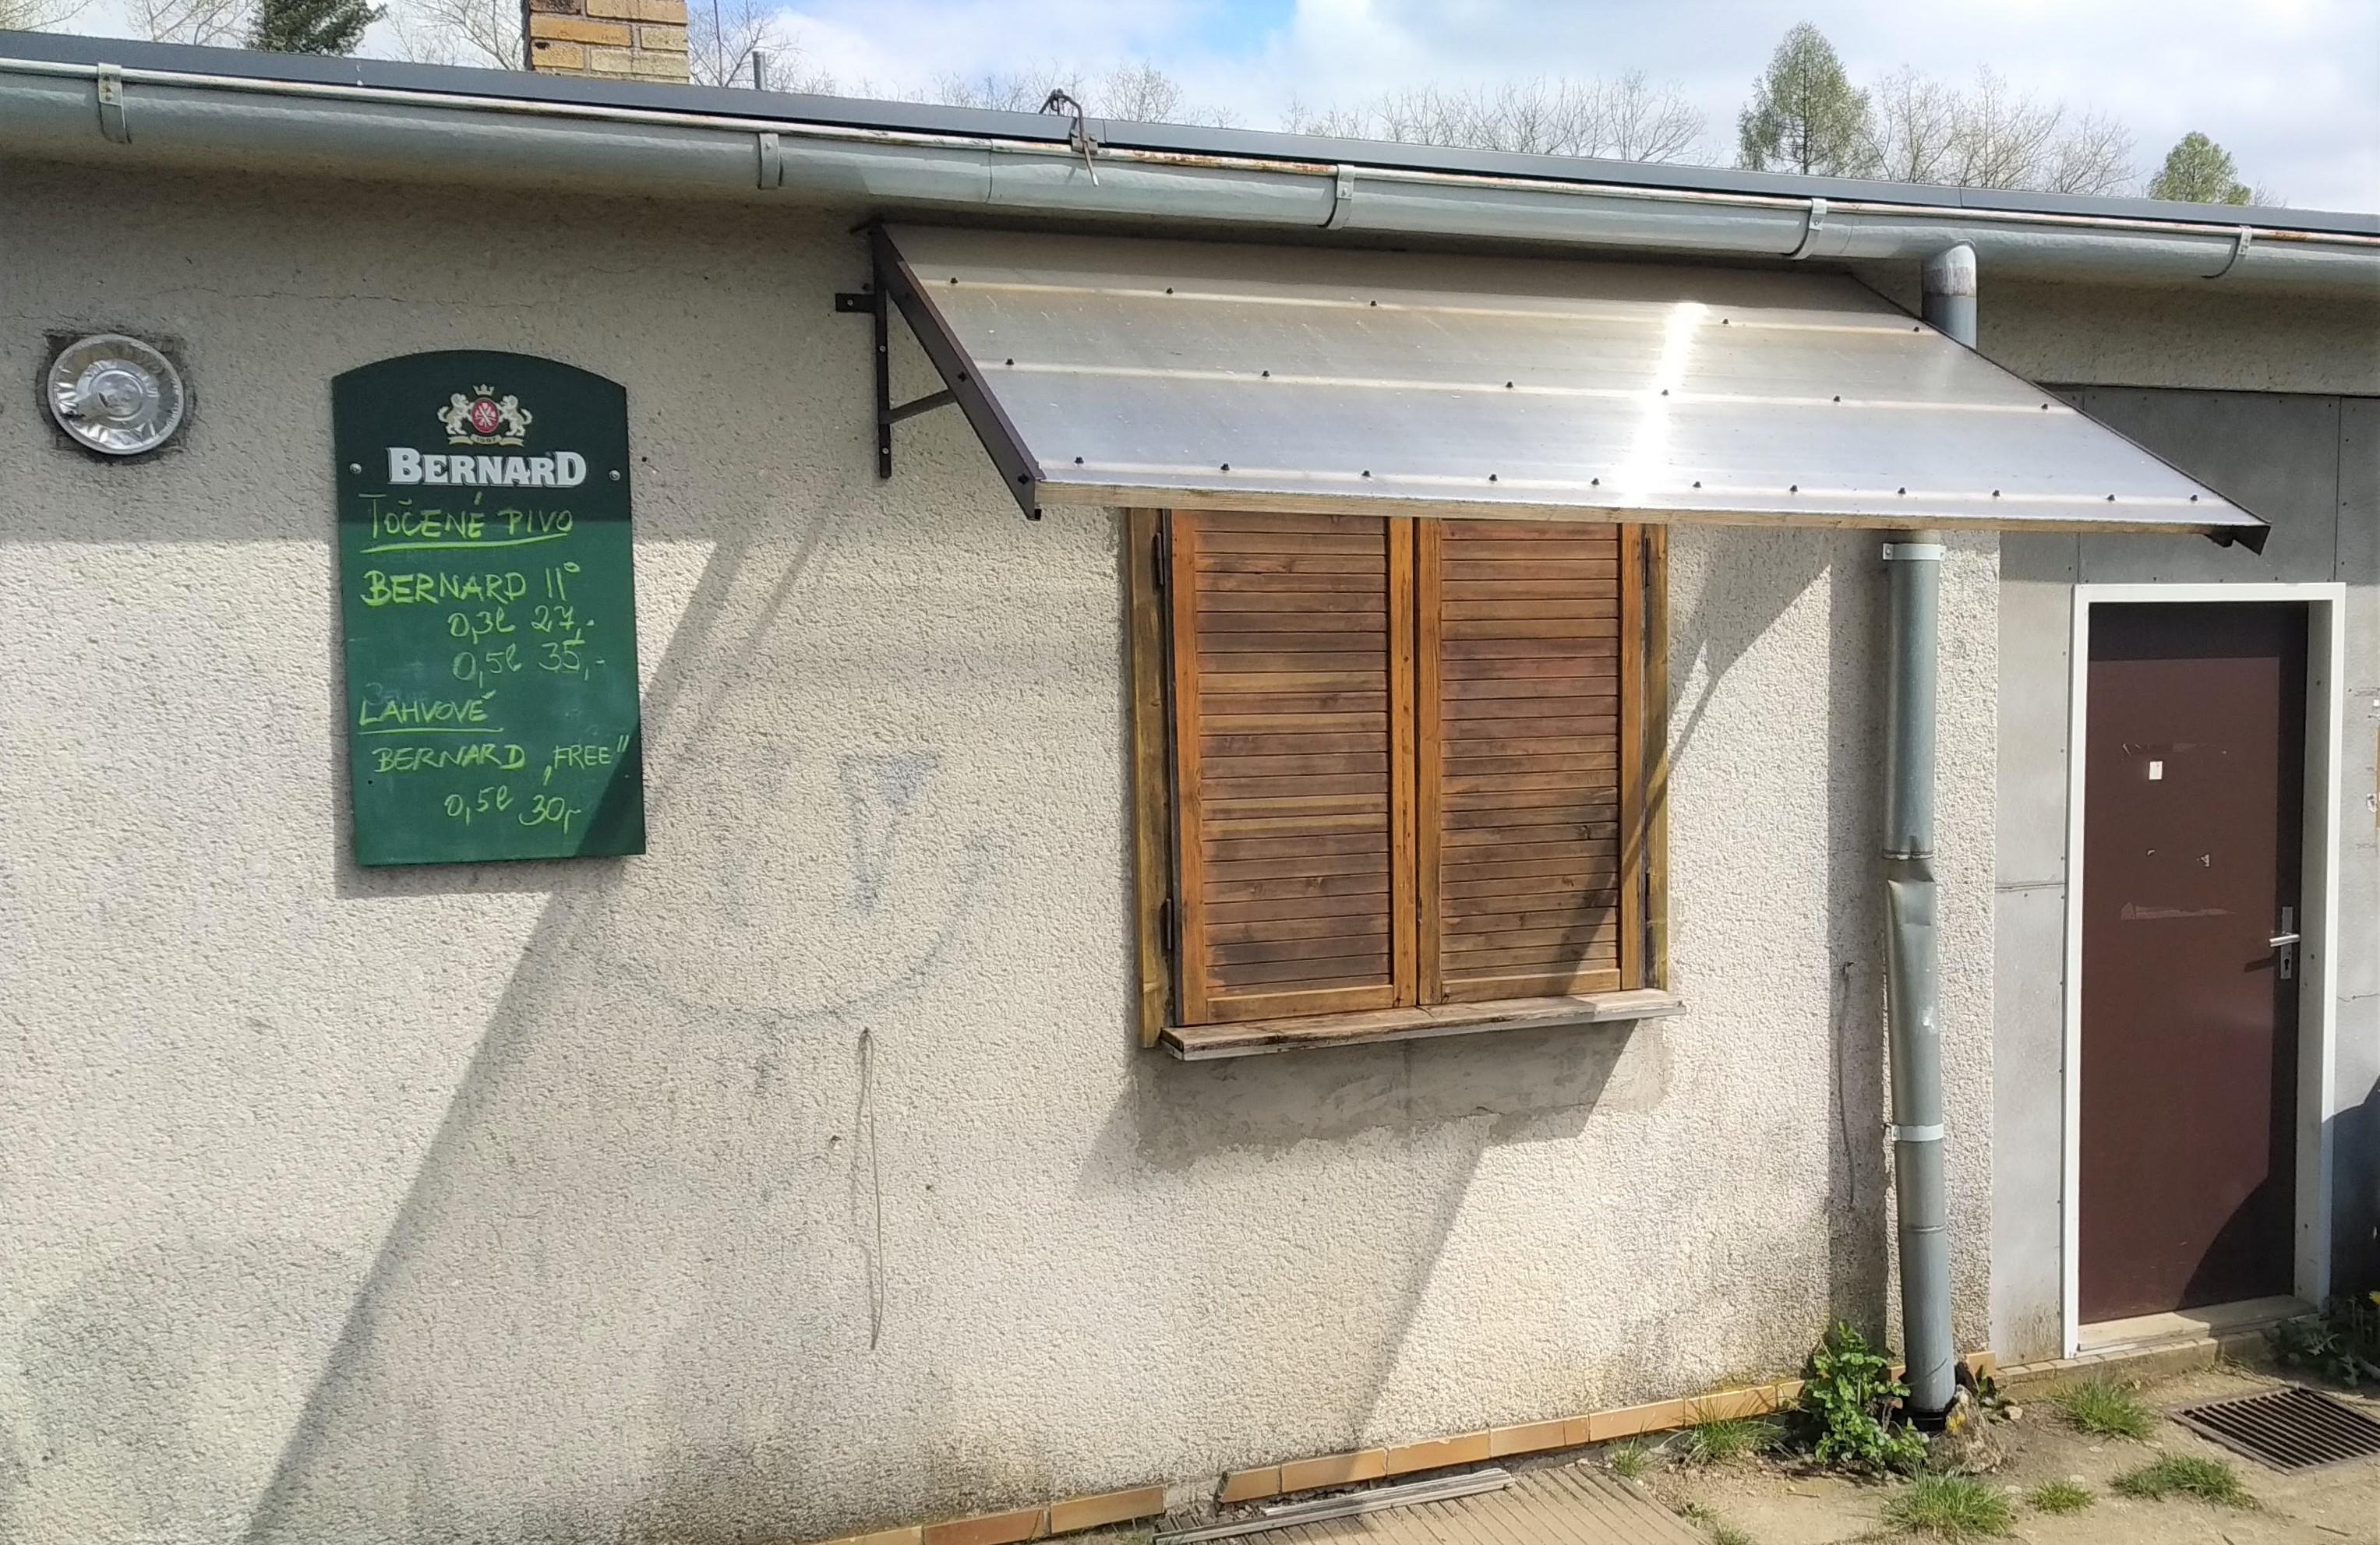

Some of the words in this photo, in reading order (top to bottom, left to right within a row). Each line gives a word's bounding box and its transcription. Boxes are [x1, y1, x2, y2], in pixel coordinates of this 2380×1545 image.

[498, 507, 574, 535] PIVO
[361, 570, 526, 606] BERNARD
[358, 690, 496, 726] LAHVOVÉ
[370, 743, 525, 774] BERNARD
